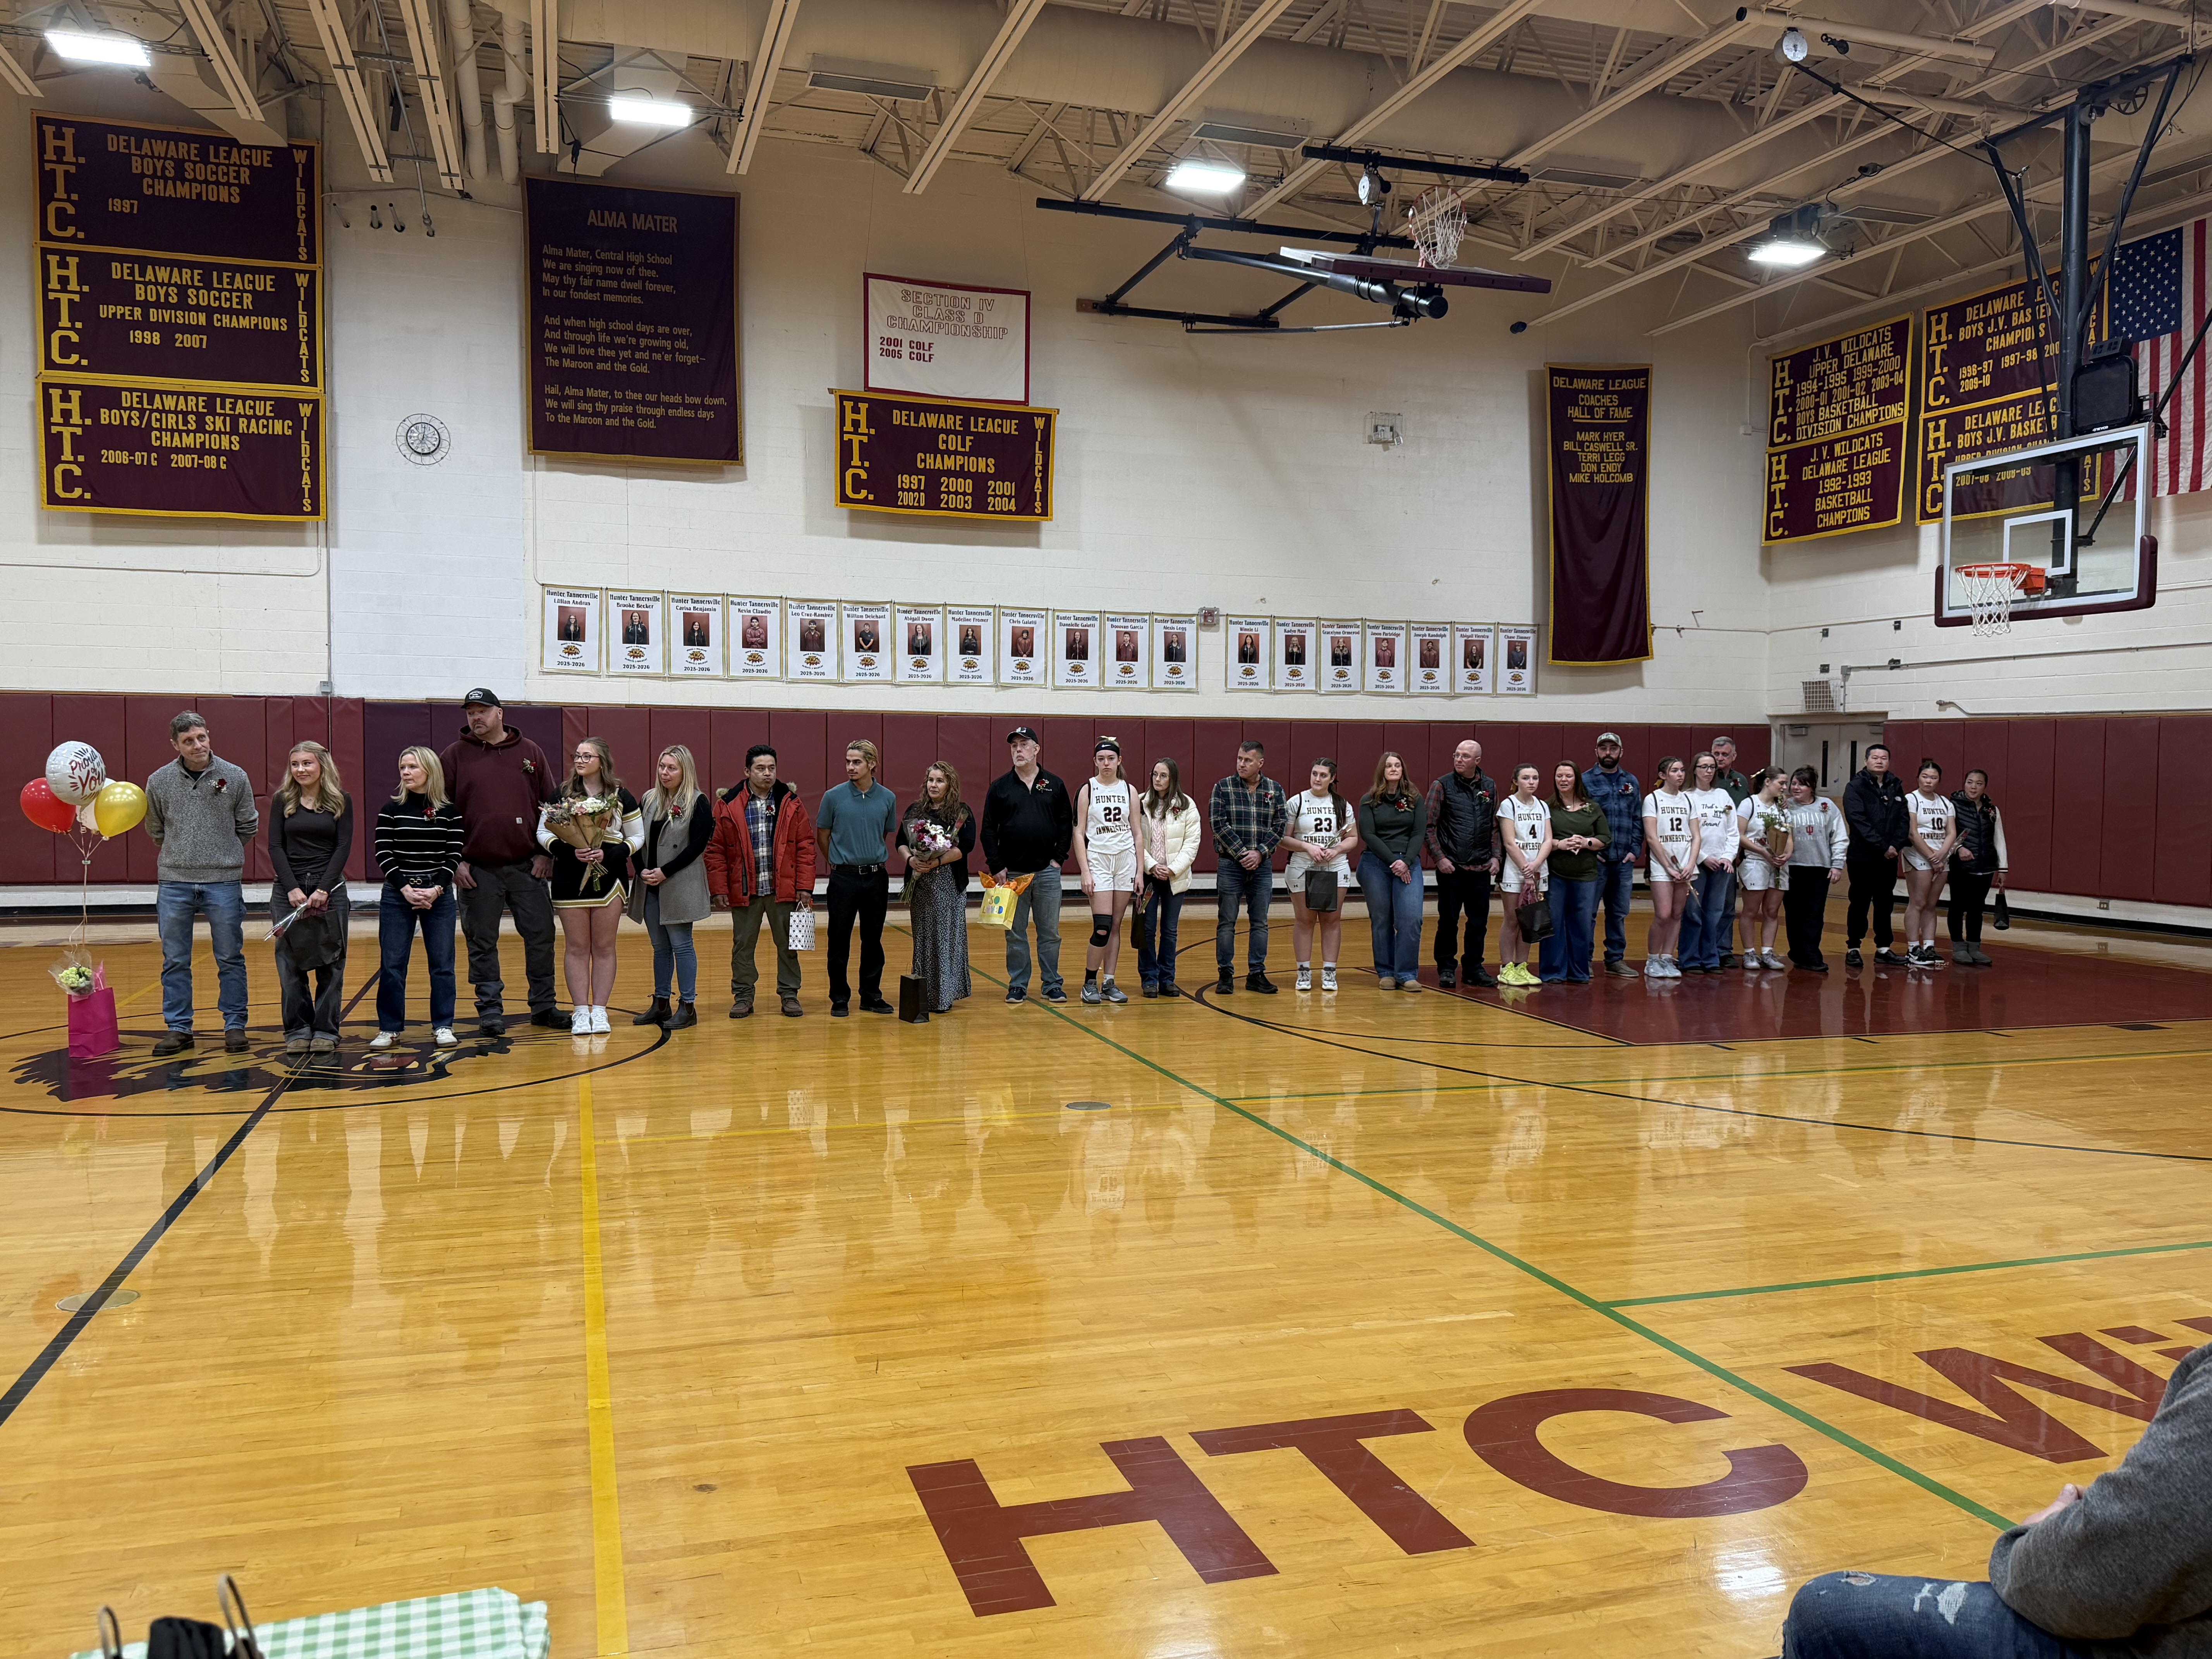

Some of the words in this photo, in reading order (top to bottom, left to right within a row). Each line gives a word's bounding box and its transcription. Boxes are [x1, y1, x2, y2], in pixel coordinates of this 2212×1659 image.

[107, 134, 199, 160] DELAWARE
[210, 145, 272, 167] LEAGUE
[132, 156, 174, 177] BOYS
[184, 162, 250, 184] SOCCER
[143, 178, 240, 203] CHAMPIONS
[109, 198, 137, 213] 1997
[293, 149, 307, 261] WILDCATS
[587, 210, 627, 228] ALMA
[633, 213, 677, 233] MATER
[543, 244, 562, 256] Alma
[566, 247, 592, 260] Mater,
[596, 249, 623, 260] Central
[627, 252, 644, 264] High
[647, 254, 672, 264] School
[112, 262, 203, 286] DELAWARE
[213, 271, 275, 291] LEAGUE
[543, 258, 556, 269] We
[575, 262, 602, 275] singing
[627, 266, 635, 275] of
[639, 266, 658, 277] thee.
[136, 284, 177, 303] BOYS
[188, 289, 252, 309] SOCCER
[902, 289, 970, 309] SECTION
[979, 299, 994, 311] IV
[1966, 291, 2025, 323] DELAWARE
[100, 305, 142, 320] UPPER
[150, 309, 206, 325] DIVISION
[214, 314, 287, 331] CHAMPIONS
[913, 305, 965, 323] CLASS
[974, 312, 983, 324] D
[295, 273, 309, 382] WILDCATS
[887, 315, 1008, 339] CHAMPIONSHIP
[1959, 322, 1983, 341] BOYS
[1988, 315, 2007, 333] J.V.
[130, 330, 160, 345] 1998
[175, 333, 206, 348] 2007
[880, 337, 902, 347] 2001
[909, 340, 934, 351] GOLF
[1813, 348, 1820, 362] J.
[1825, 345, 1832, 359] V.
[1841, 326, 1891, 354] WILDCATS
[880, 347, 902, 359] 2005
[909, 351, 934, 362] GOLF
[1810, 358, 1838, 378] UPPER
[1844, 340, 1894, 369] DELAWARE
[1960, 360, 1992, 379] 1996-97
[2002, 348, 2037, 368] 1997-98
[1553, 376, 1604, 390] DELAWARE
[1609, 378, 1646, 390] LEAGUE
[1796, 370, 1846, 397] 1994-1995
[1853, 356, 1900, 381] 1999-2000
[1960, 374, 1990, 392] 2009-10
[1579, 394, 1618, 405] COACHES
[1796, 391, 1827, 412] 2000-01
[1832, 381, 1865, 403] 2001-02
[1872, 370, 1903, 392] 2003-04
[122, 392, 207, 412] DELAWARE
[216, 398, 274, 416] LEAGUE
[1568, 406, 1590, 418] HALL
[1594, 408, 1605, 418] OF
[1609, 407, 1633, 418] FAME
[1796, 409, 1814, 426] BOYS
[1819, 392, 1878, 422] BASKETBALL
[100, 409, 196, 429] BOYS/GIRLS
[206, 416, 230, 431] SKI
[239, 418, 292, 435] RACING
[893, 410, 963, 430] DELAWARE
[971, 417, 1018, 434] LEAGUE
[1796, 417, 1841, 440] DIVISION
[1848, 402, 1903, 428] CHAMPIONS
[1965, 405, 2023, 430] DELAWARE
[151, 431, 239, 450] CHAMPIONS
[939, 434, 974, 452] GOLF
[1564, 441, 1581, 451] BILL
[1584, 443, 1623, 452] CASWELL
[1626, 442, 1638, 451] SR.
[1577, 432, 1600, 441] MARK
[1603, 432, 1624, 441] HYER
[1810, 448, 1819, 462] J.
[1822, 446, 1829, 459] V.
[1834, 432, 1883, 457] WILDCATS
[1958, 431, 1982, 448] BOYS
[1987, 426, 2005, 443] J.V.
[299, 403, 313, 511] WILDCATS
[917, 453, 994, 473] CHAMPIONS
[1034, 417, 1045, 513] WILDCATS
[1578, 452, 1600, 462] TERRI
[1604, 452, 1625, 462] LEGG
[1581, 463, 1597, 472] DON
[1601, 463, 1621, 472] ENDY
[1803, 458, 1848, 480] DELAWARE
[1854, 448, 1891, 469] LEAGUE
[898, 474, 925, 489] 1997
[941, 477, 972, 493] 2000
[988, 481, 1015, 496] 2001
[1570, 473, 1590, 483] MIKE
[1594, 473, 1633, 483] HOLCOMB
[1819, 471, 1871, 494] 1992-1993
[898, 491, 924, 506] 2002D
[941, 494, 972, 509] 2003
[988, 497, 1016, 511] 2004
[1815, 488, 1873, 511] BASKETBALL
[1817, 506, 1870, 527] CHAMPIONS
[567, 591, 598, 600] Tannersville
[1095, 795, 1125, 804] HUNTER
[1104, 807, 1121, 822] 22
[1661, 807, 1687, 815] HUNTER
[1314, 818, 1332, 832] 23
[1529, 824, 1537, 838] 4
[1669, 817, 1682, 831] 12
[1931, 817, 1943, 830] 10
